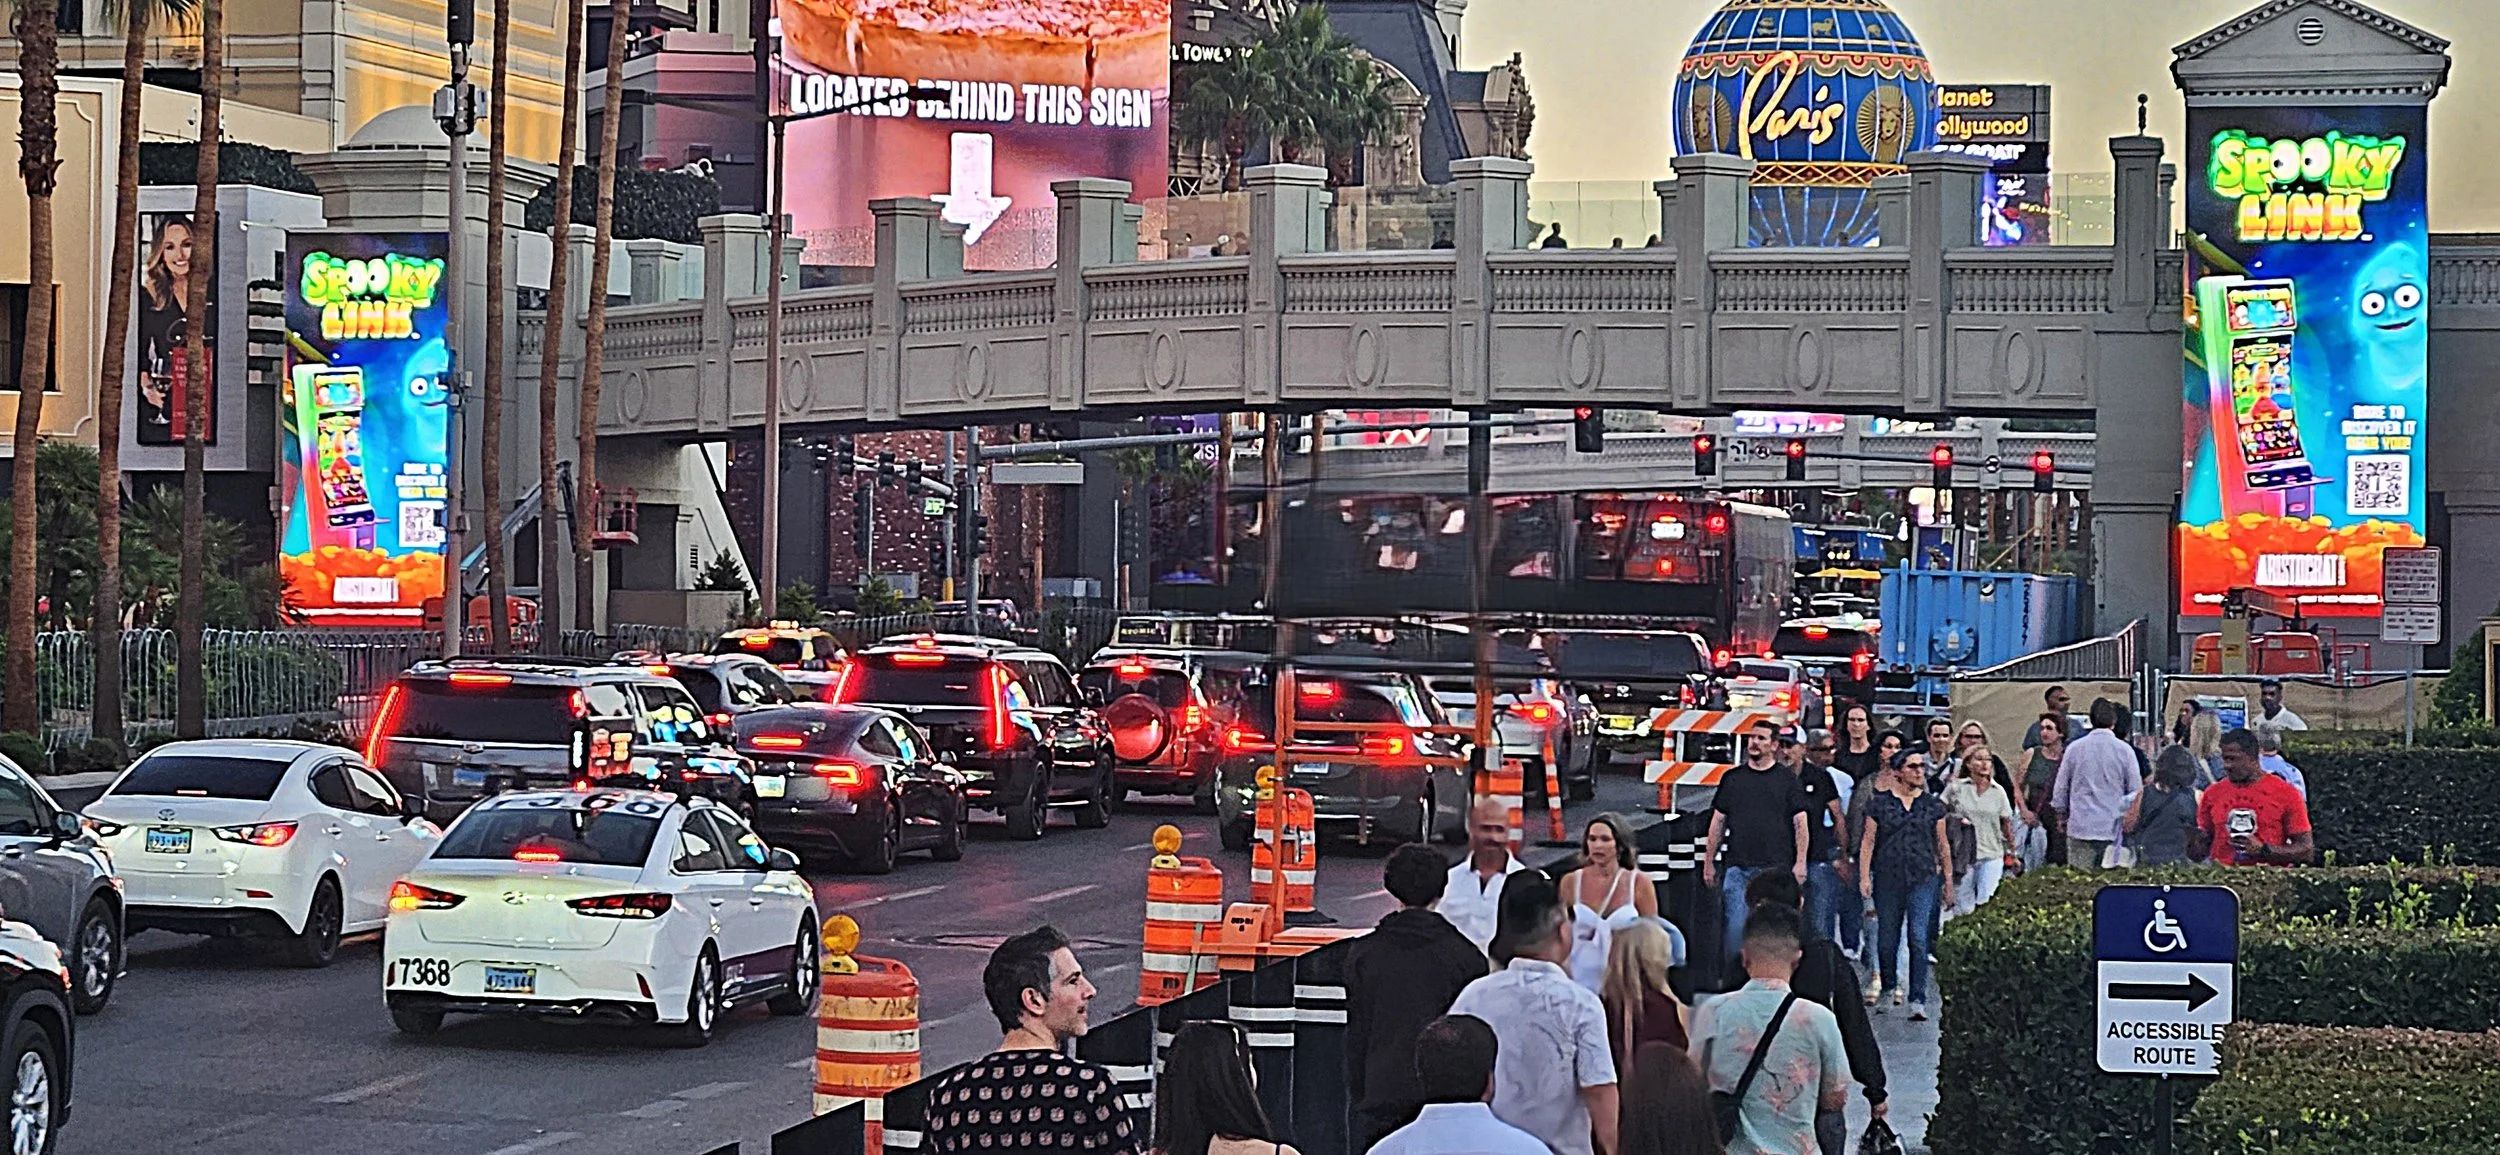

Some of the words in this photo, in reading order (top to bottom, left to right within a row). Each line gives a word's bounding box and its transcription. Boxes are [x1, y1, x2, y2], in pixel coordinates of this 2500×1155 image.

[790, 73, 909, 117] LOCATED
[917, 79, 1015, 121] BEHIND
[1022, 84, 1083, 125] THIS
[1090, 88, 1151, 127] SIGN
[1739, 50, 1844, 160] Paris
[1937, 86, 1994, 107] lanet
[1936, 115, 2029, 140] ollywood
[2209, 130, 2406, 200] SPOOKY
[2238, 192, 2364, 241] LINK
[301, 252, 445, 307] SPOOKY
[321, 301, 413, 340] LINK
[399, 957, 450, 986] 7368
[2107, 1021, 2224, 1040] ACCESSIBLE
[2133, 1046, 2196, 1065] ROUTE
